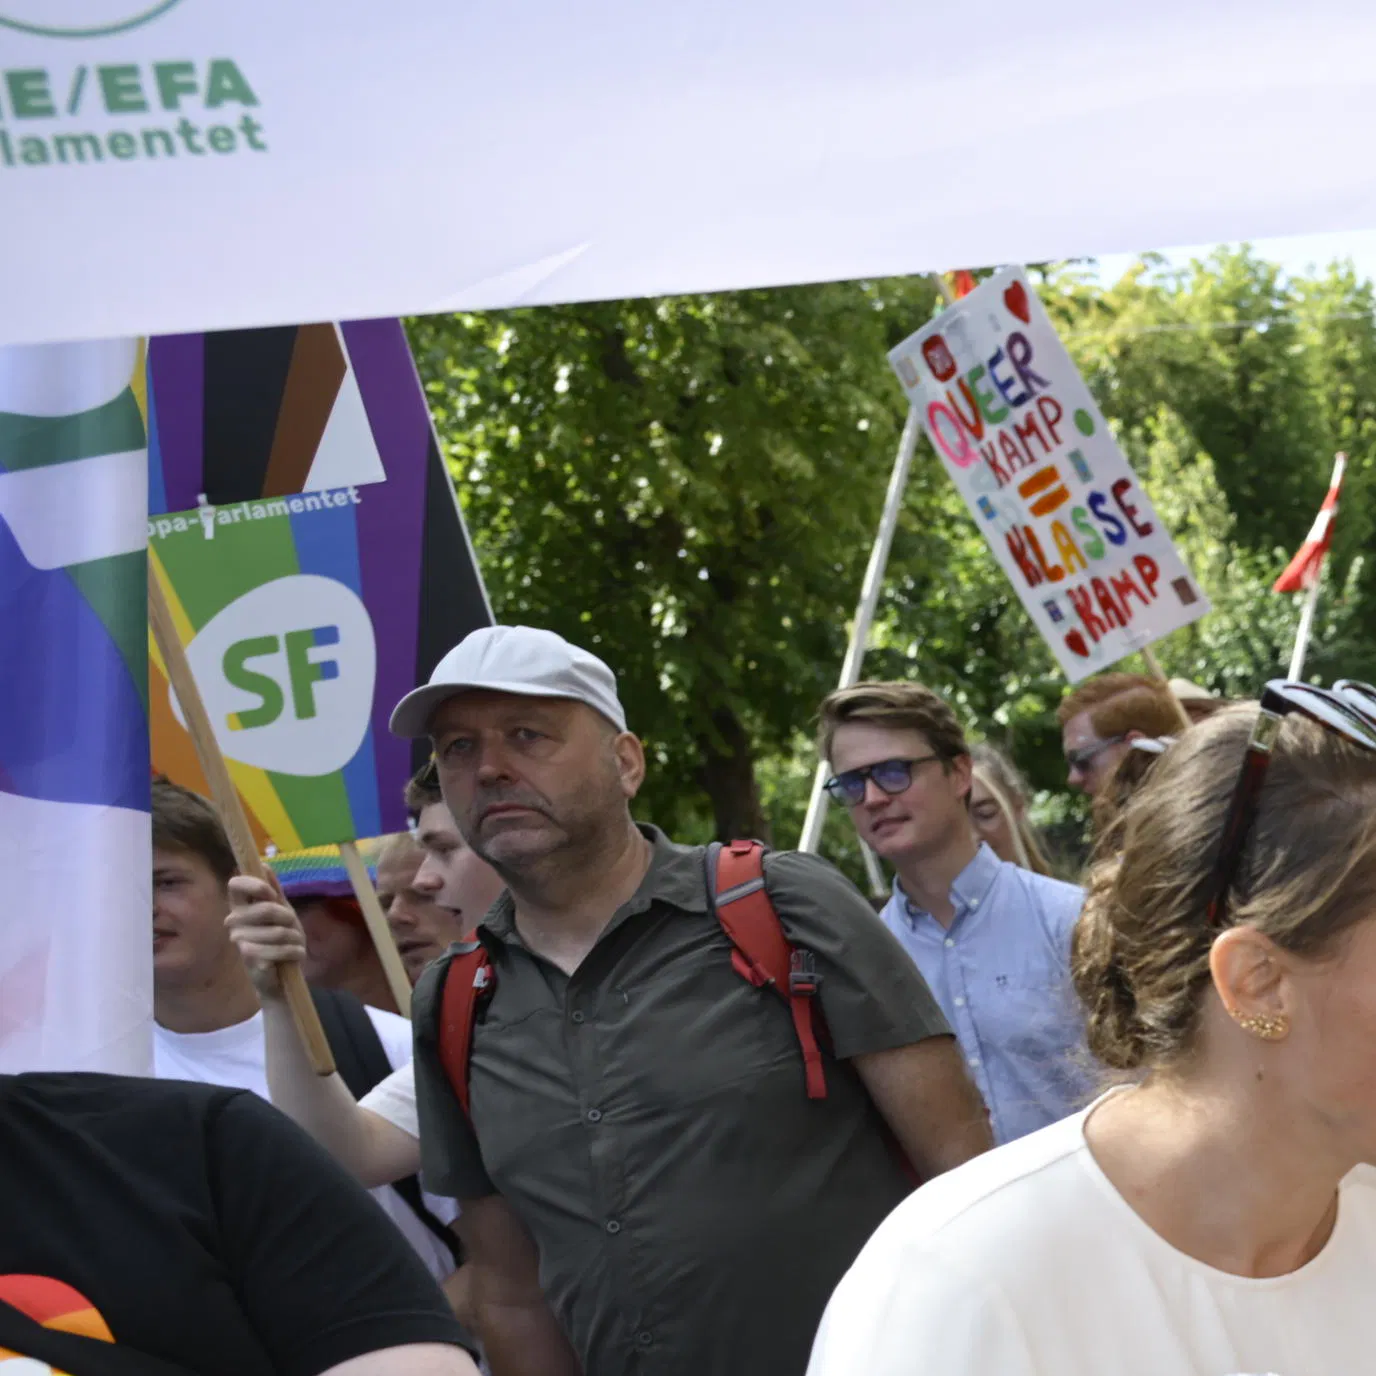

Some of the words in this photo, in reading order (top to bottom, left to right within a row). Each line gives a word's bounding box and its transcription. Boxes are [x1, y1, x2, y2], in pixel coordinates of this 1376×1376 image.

[0, 57, 262, 119] E/EFA
[0, 112, 269, 168] lamentet
[926, 331, 1050, 469] QUEER
[980, 396, 1063, 489] KAMP
[147, 486, 362, 540] opa-arlamentet
[1005, 478, 1154, 589] KLASSE
[1066, 554, 1160, 643] KAMP
[222, 625, 340, 731] SF
